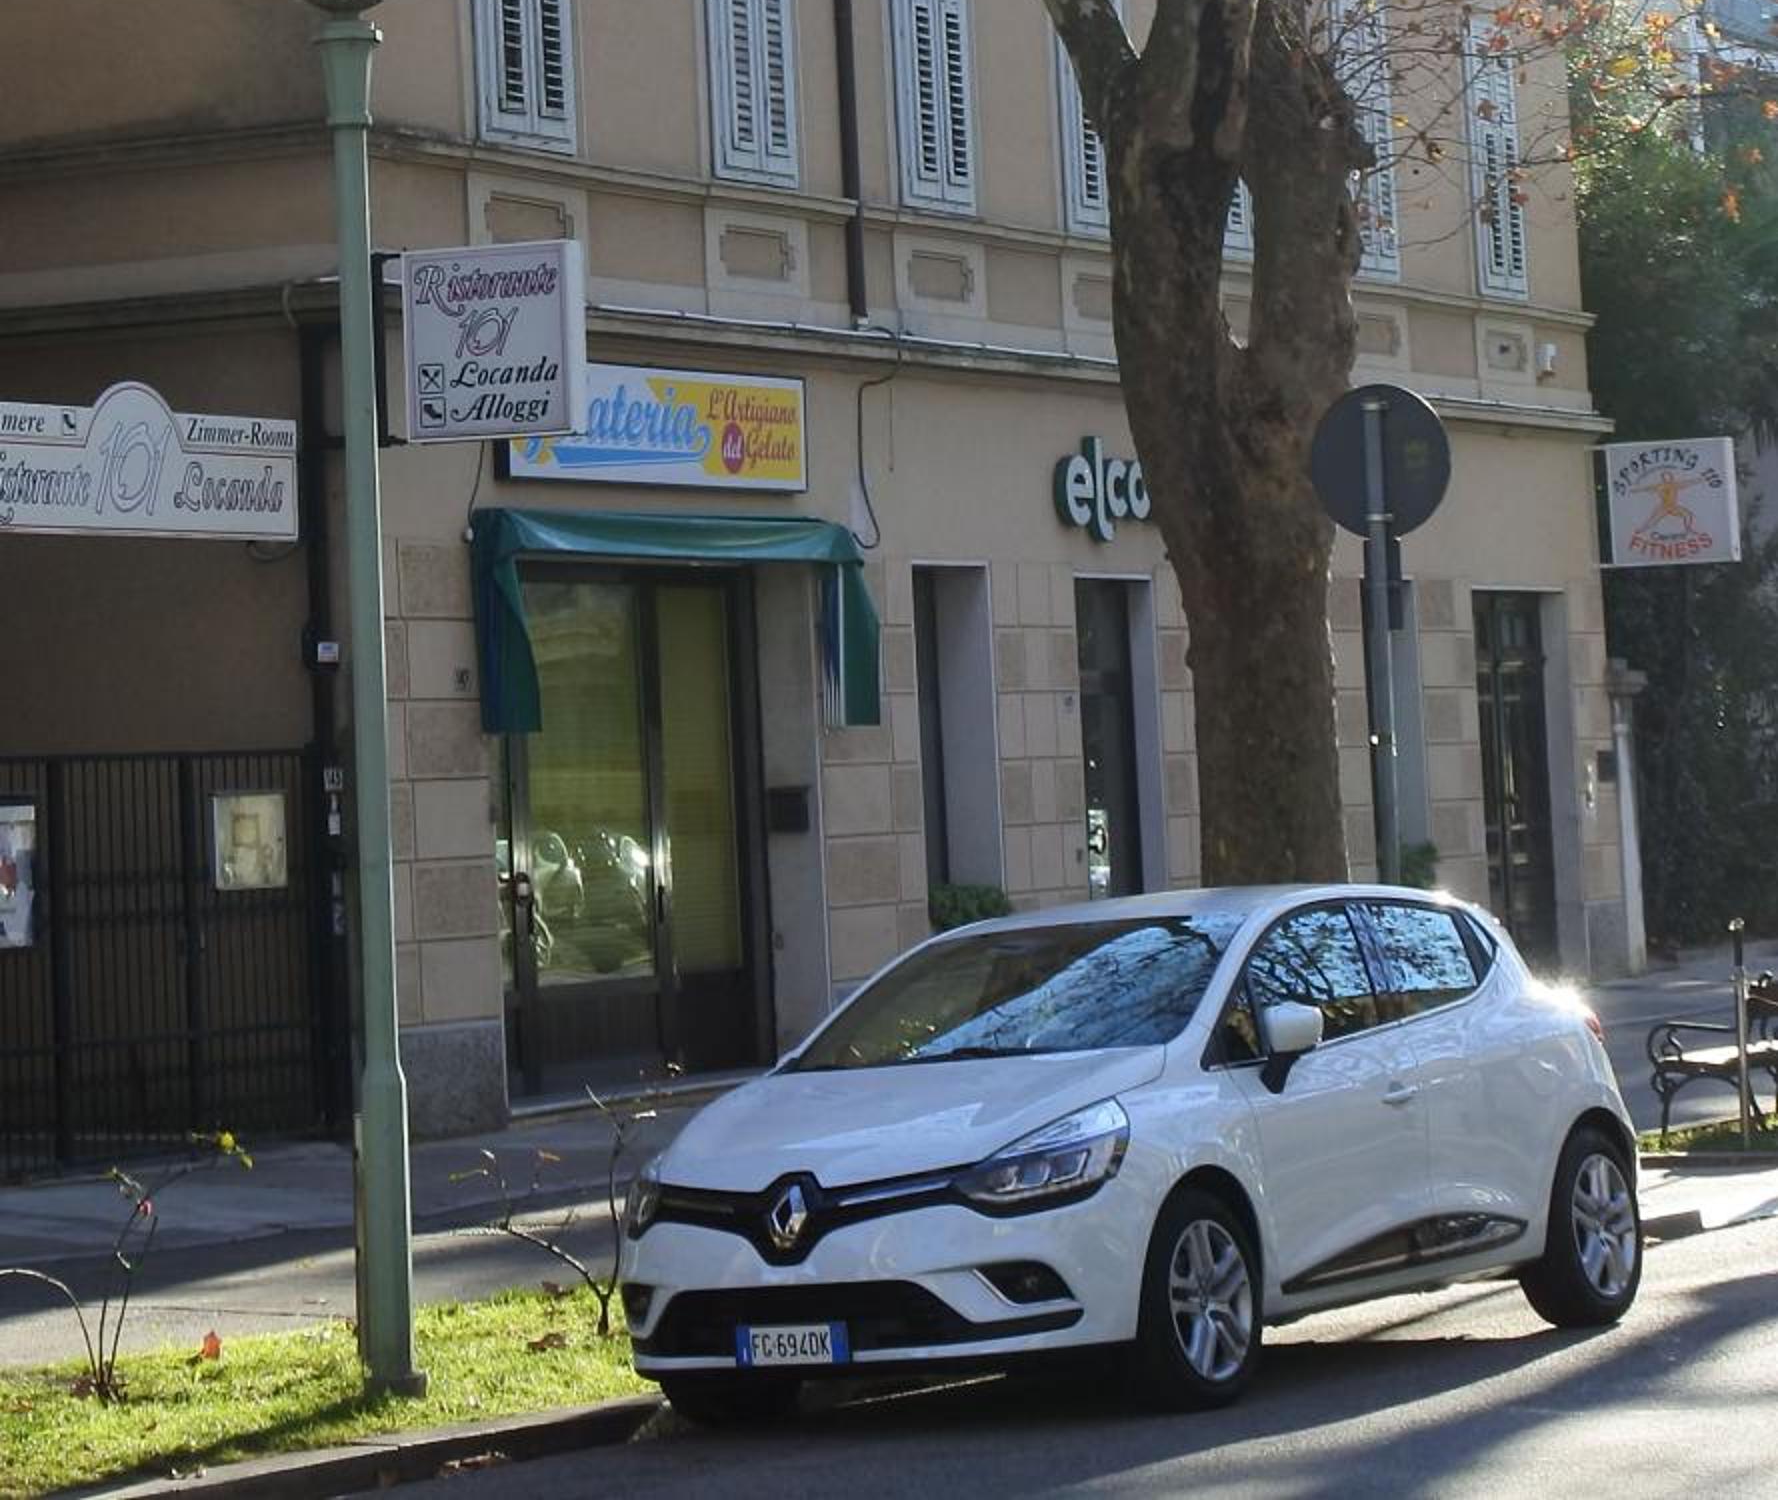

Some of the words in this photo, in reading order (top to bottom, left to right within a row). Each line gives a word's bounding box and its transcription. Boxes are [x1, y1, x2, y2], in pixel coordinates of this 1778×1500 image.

[414, 263, 558, 317] Ristorante
[450, 356, 559, 388] Locanda
[1, 410, 46, 432] mere
[449, 390, 551, 422] Alloggi
[588, 384, 712, 453] ateria
[186, 417, 295, 447] Zimmer-Rooms
[746, 430, 795, 467] Gelato
[174, 461, 285, 513] Locanda
[1613, 447, 1699, 498] SPORTING
[1630, 531, 1713, 559] FITNESS
